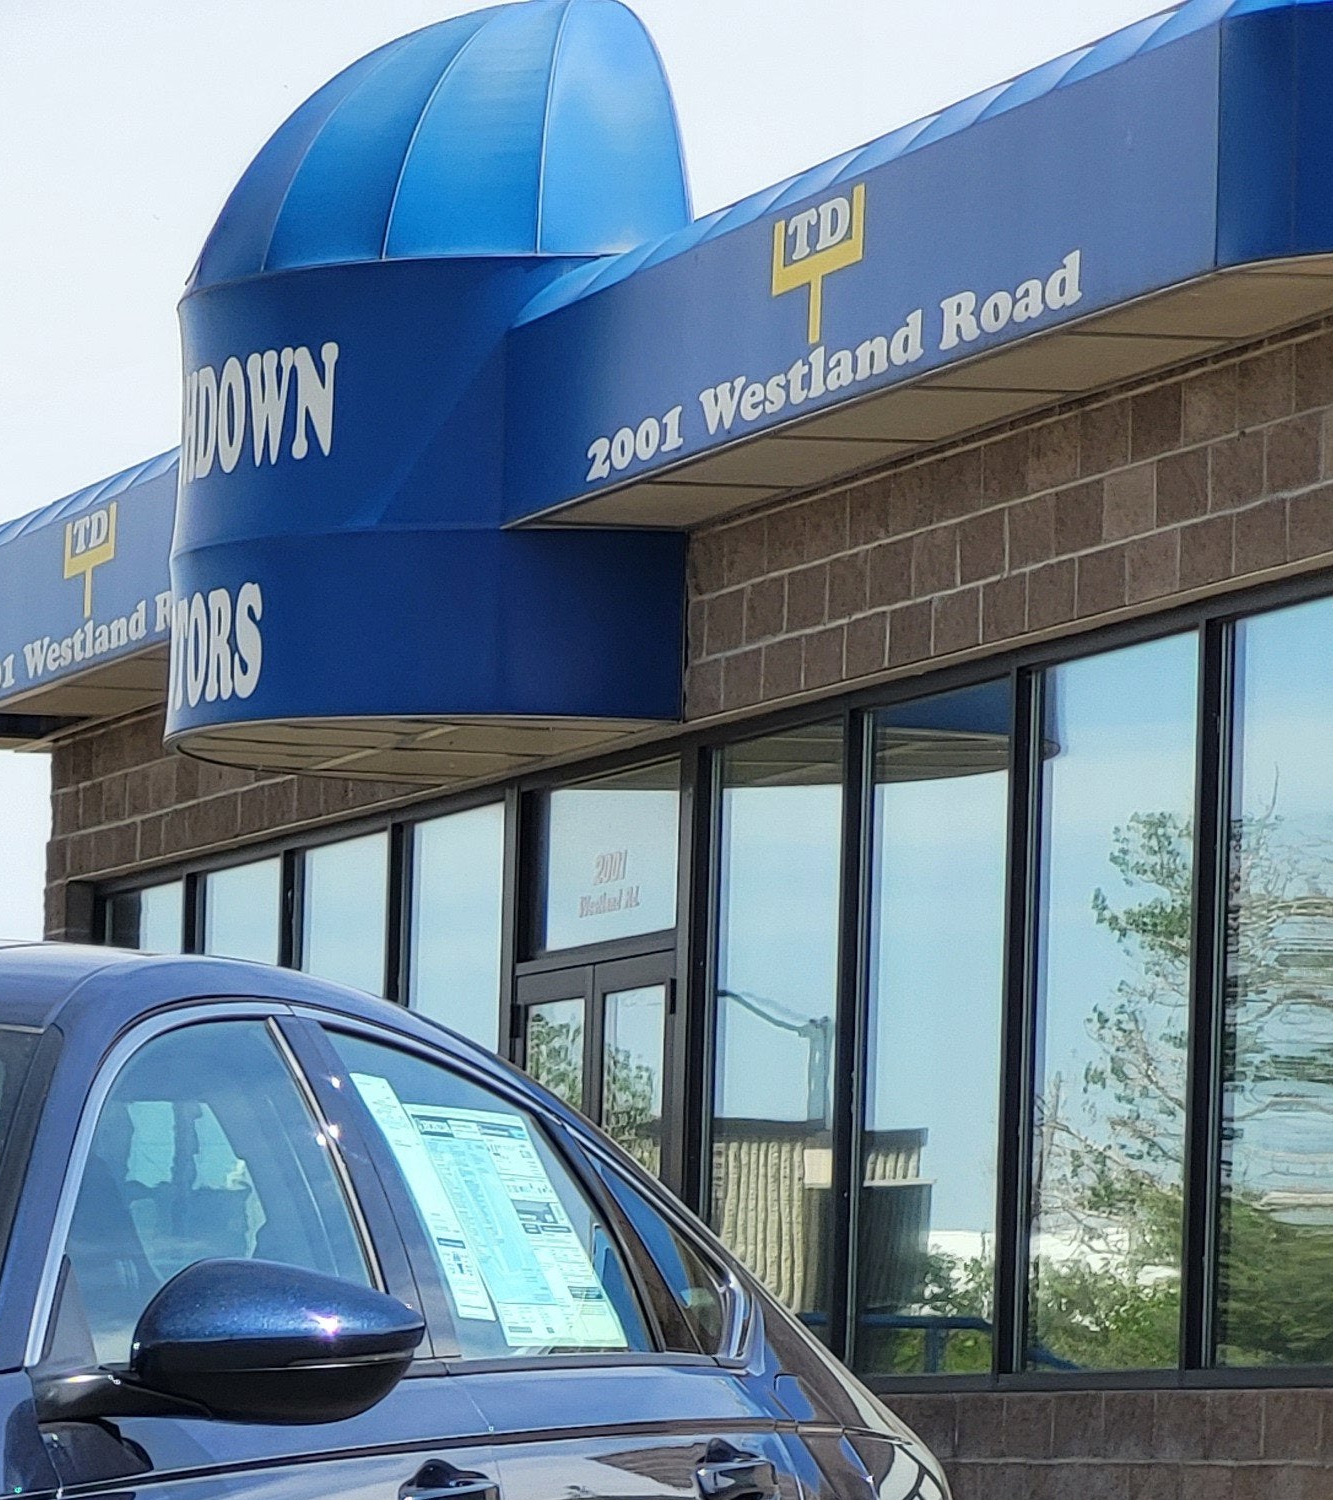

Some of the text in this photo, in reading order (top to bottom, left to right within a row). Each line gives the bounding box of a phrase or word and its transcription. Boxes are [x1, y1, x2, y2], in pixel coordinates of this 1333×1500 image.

[788, 197, 841, 261] TD
[585, 249, 1083, 483] 2001 Westland Road
[73, 509, 109, 554] TD
[23, 600, 147, 679] Westland
